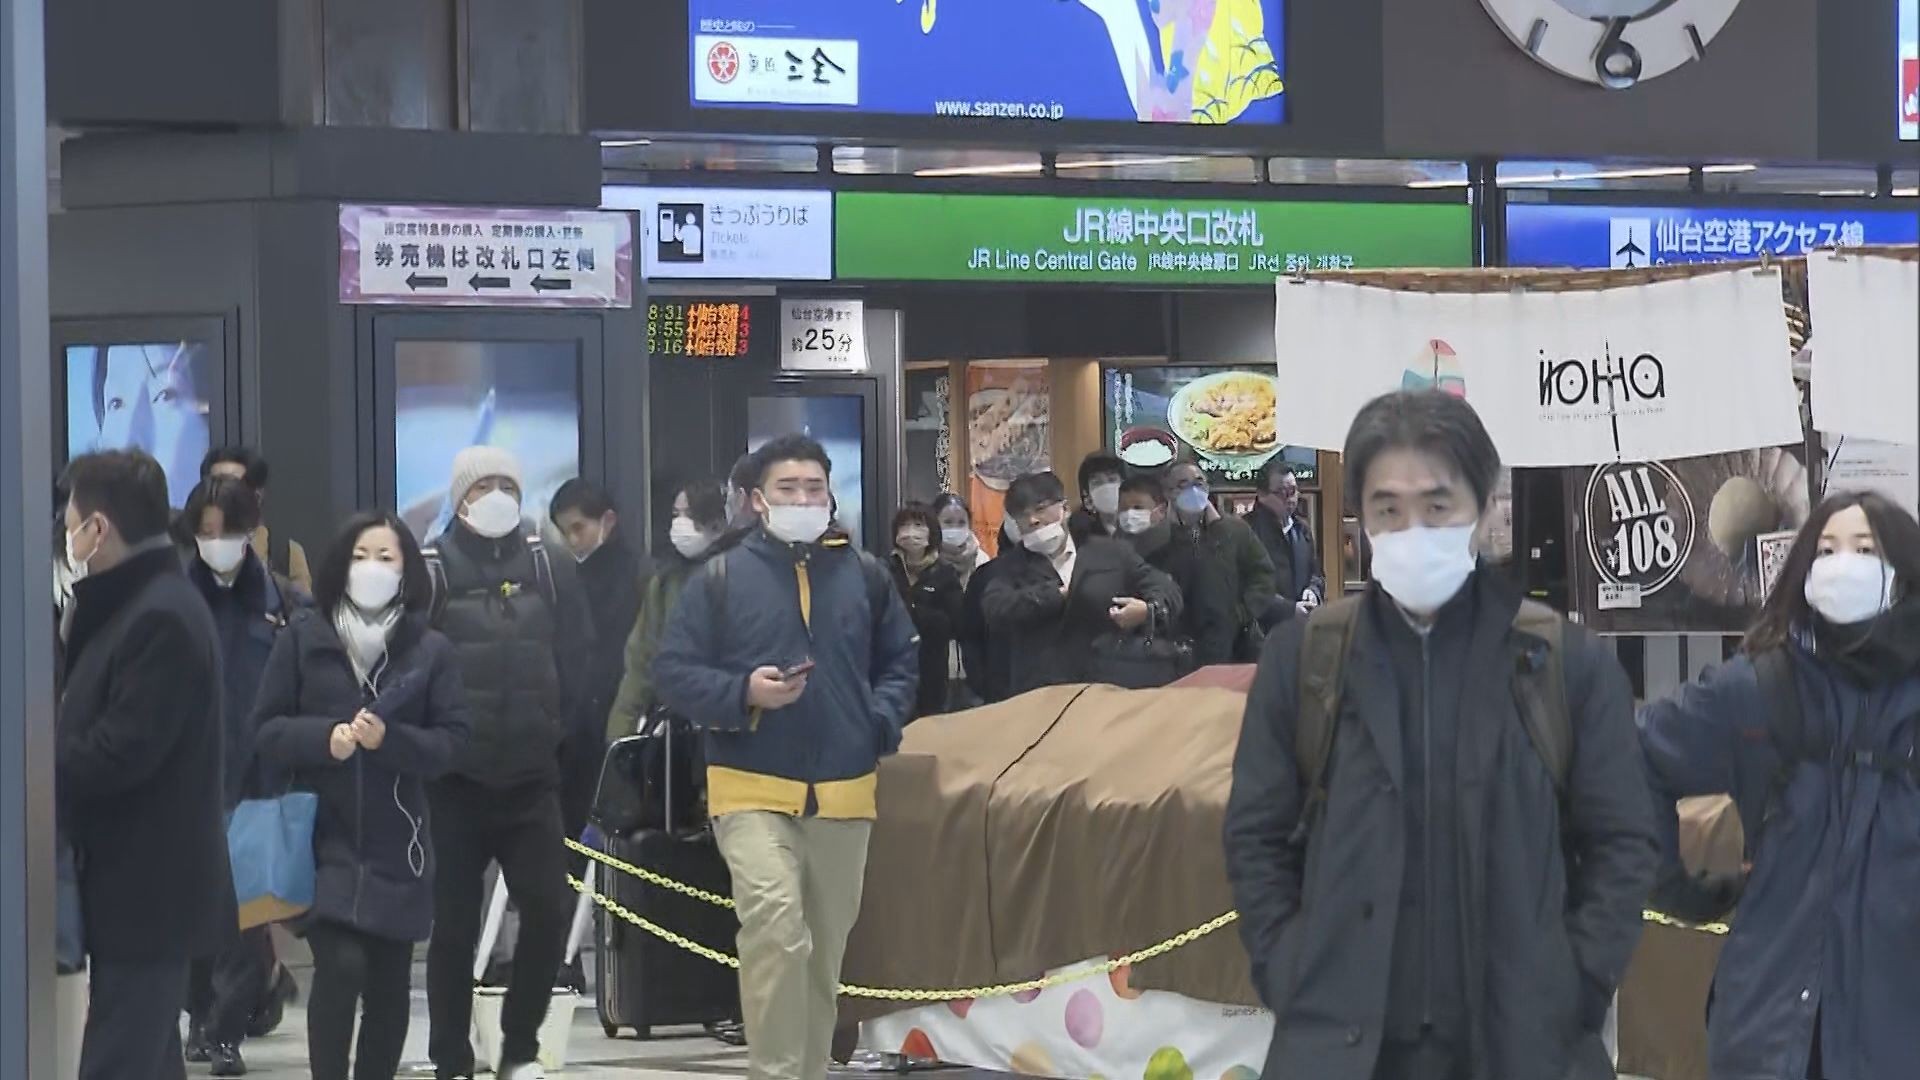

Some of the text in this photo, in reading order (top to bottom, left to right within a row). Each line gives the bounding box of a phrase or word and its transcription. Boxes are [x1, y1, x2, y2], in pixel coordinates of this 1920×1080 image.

[935, 100, 1064, 120] www.sanzen.co.jp
[709, 204, 810, 226] きっぷうりば
[1062, 208, 1264, 247] JR線中央口改札
[1655, 218, 1865, 255] 仙台空港アクセス線
[375, 241, 595, 272] 券売機は改札口左側
[967, 248, 1137, 271] JR Line Central Gate
[792, 328, 852, 352] 約25分
[1604, 467, 1667, 522] ALL
[1606, 515, 1678, 576] ¥108
